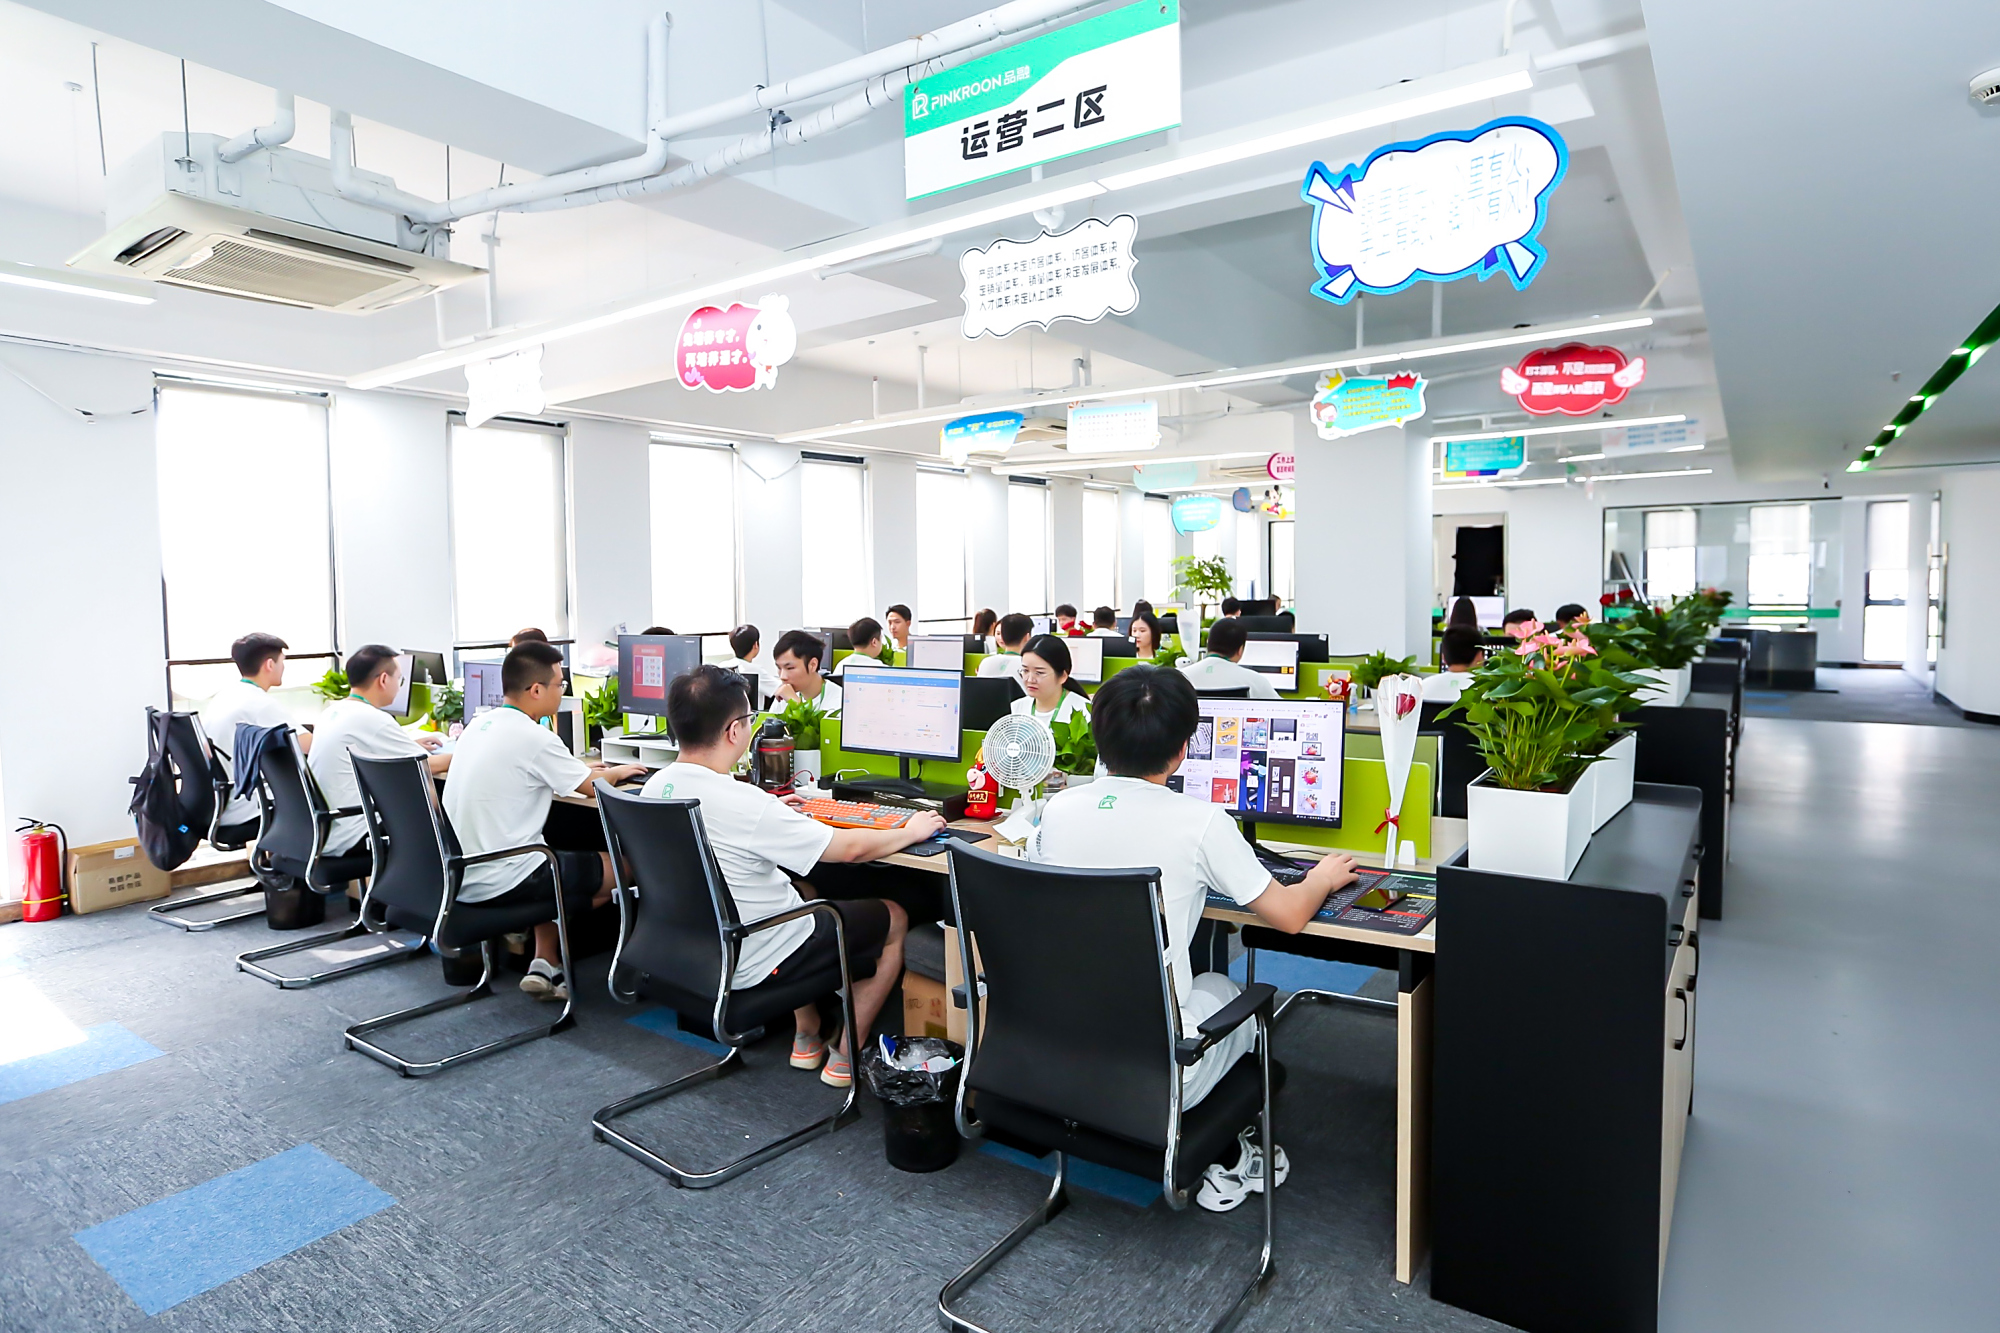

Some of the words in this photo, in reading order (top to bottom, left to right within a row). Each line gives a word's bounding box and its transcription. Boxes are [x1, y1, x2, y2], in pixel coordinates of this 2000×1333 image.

[931, 75, 1002, 110] PINKROON
[1003, 65, 1031, 86] 品融
[961, 84, 1108, 160] 运营二区
